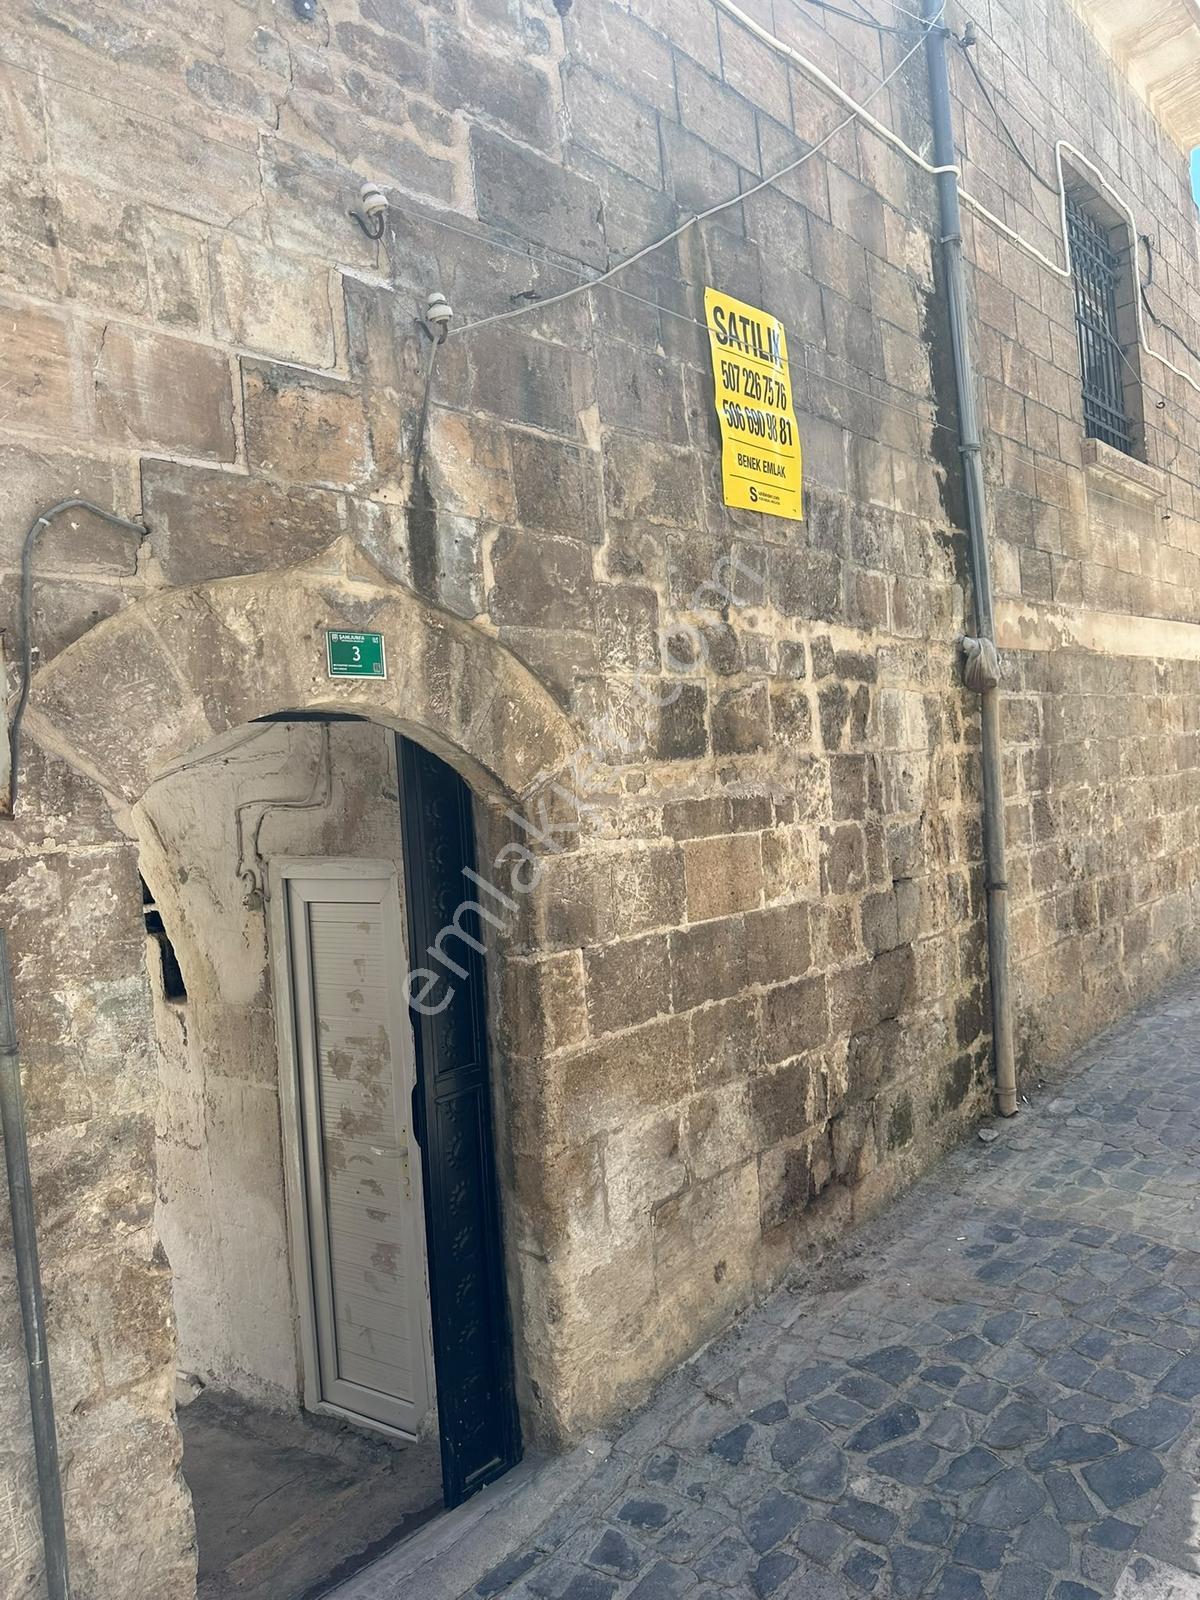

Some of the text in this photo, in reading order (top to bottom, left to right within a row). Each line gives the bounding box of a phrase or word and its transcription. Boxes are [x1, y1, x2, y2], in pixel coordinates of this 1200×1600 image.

[713, 306, 784, 369] SATILIK
[721, 360, 787, 410] 507 226 75 76
[723, 399, 745, 431] 506
[744, 406, 766, 438] 690
[780, 417, 793, 446] 81
[737, 453, 787, 479] BENEK EMLAK
[352, 645, 361, 662] 3
